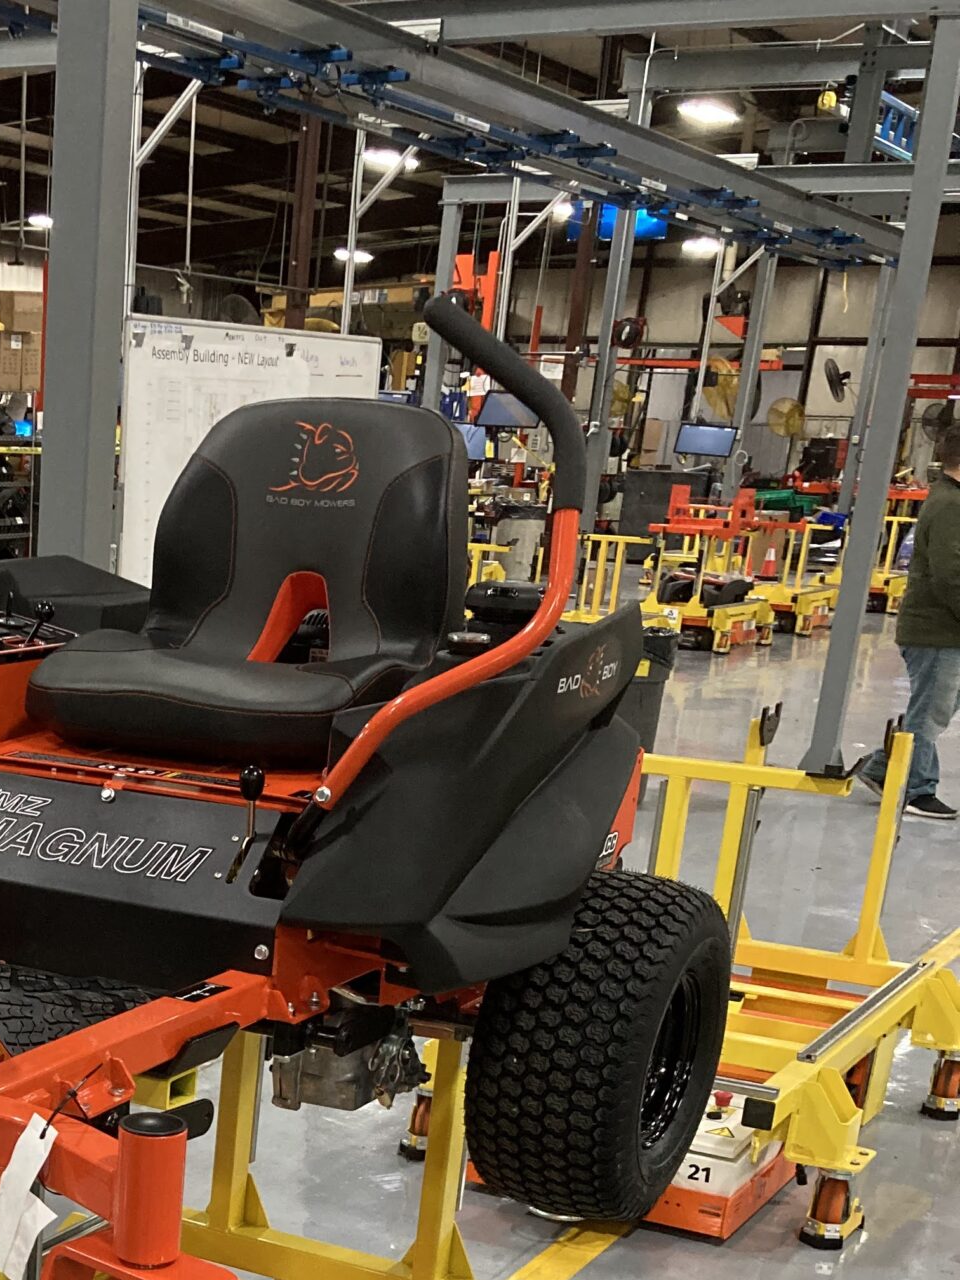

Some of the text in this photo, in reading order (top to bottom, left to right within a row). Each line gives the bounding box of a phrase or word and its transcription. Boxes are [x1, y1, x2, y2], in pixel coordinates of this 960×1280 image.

[151, 345, 190, 365] Assembly
[192, 349, 229, 367] Building
[237, 351, 255, 365] NEW
[257, 354, 280, 368] Layout
[266, 494, 356, 508] BAD BOY MOWERS
[557, 660, 619, 694] BAD BOY
[687, 1163, 712, 1184] 21
